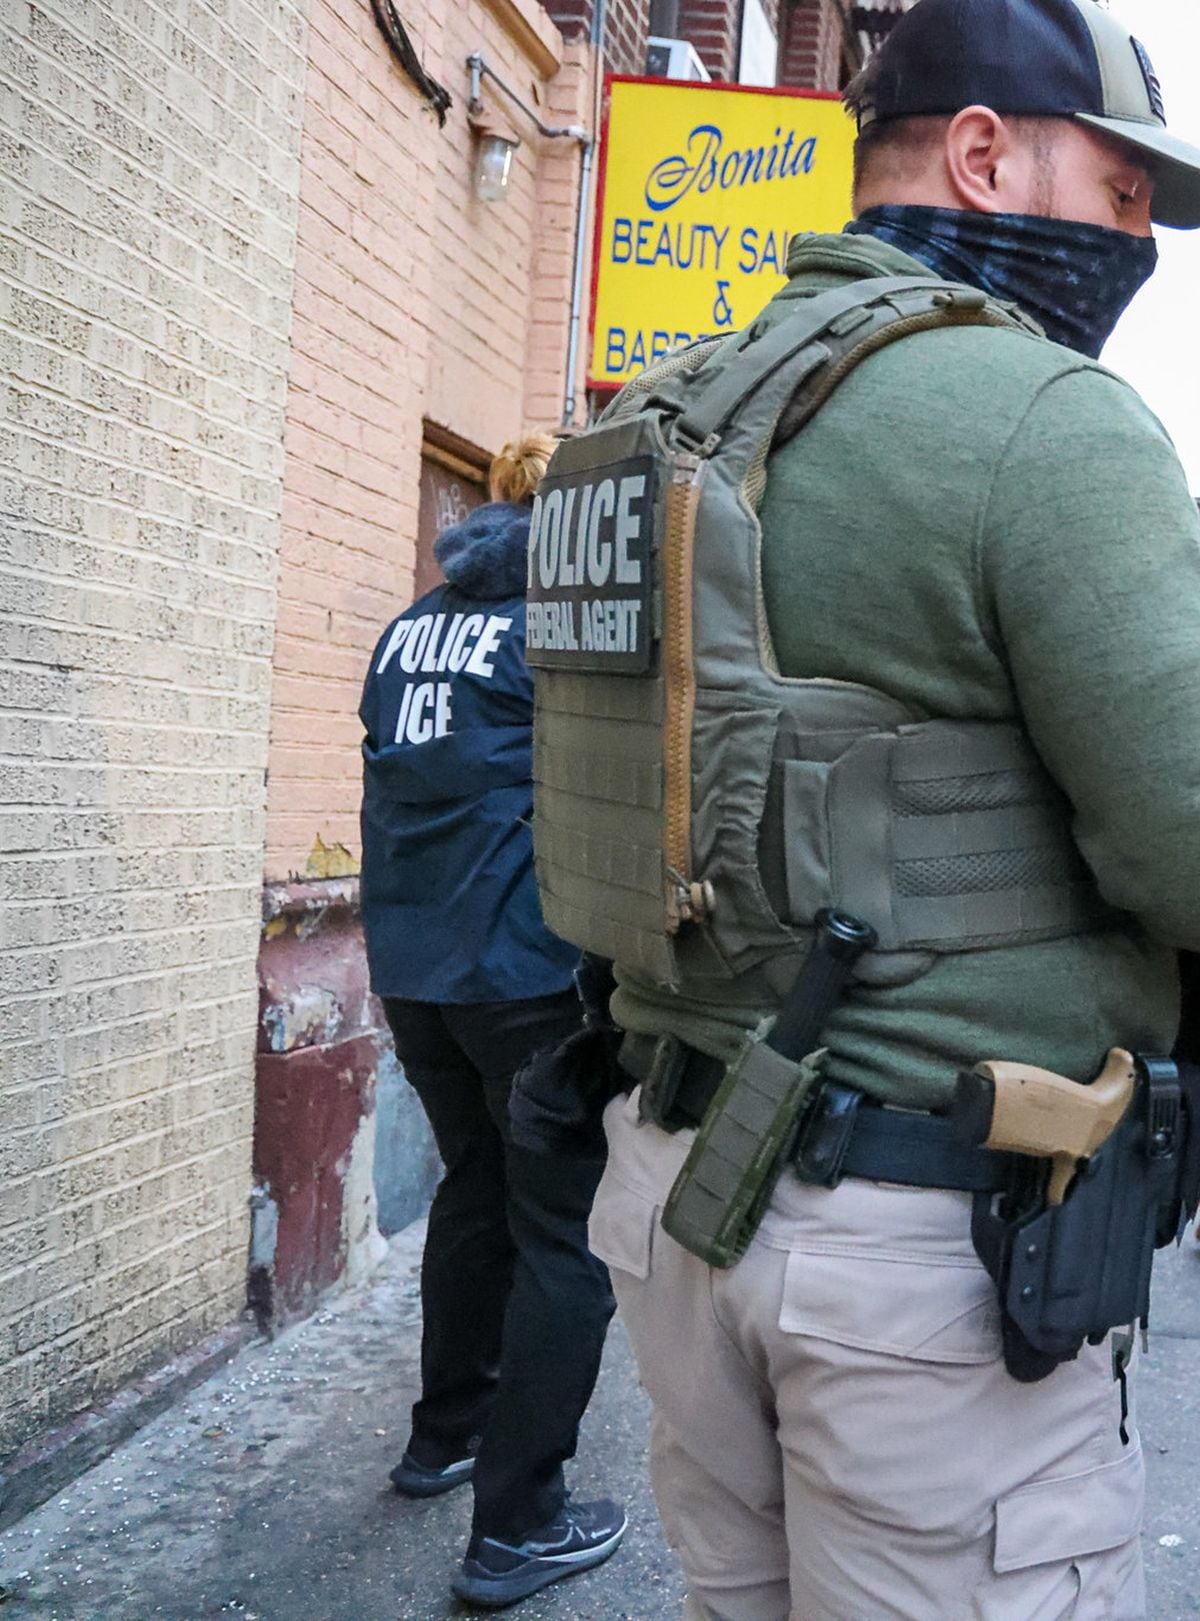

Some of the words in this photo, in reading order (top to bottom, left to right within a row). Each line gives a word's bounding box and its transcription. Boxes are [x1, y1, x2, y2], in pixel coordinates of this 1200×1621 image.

[645, 124, 817, 211] Bonita
[611, 218, 729, 270] BEAUTY
[739, 227, 815, 274] SAL
[713, 281, 732, 326] &
[606, 327, 710, 373] BAR
[527, 475, 646, 589] POLICE
[376, 613, 513, 678] POLICE
[581, 599, 641, 652] AGENT
[394, 682, 454, 744] ICE
